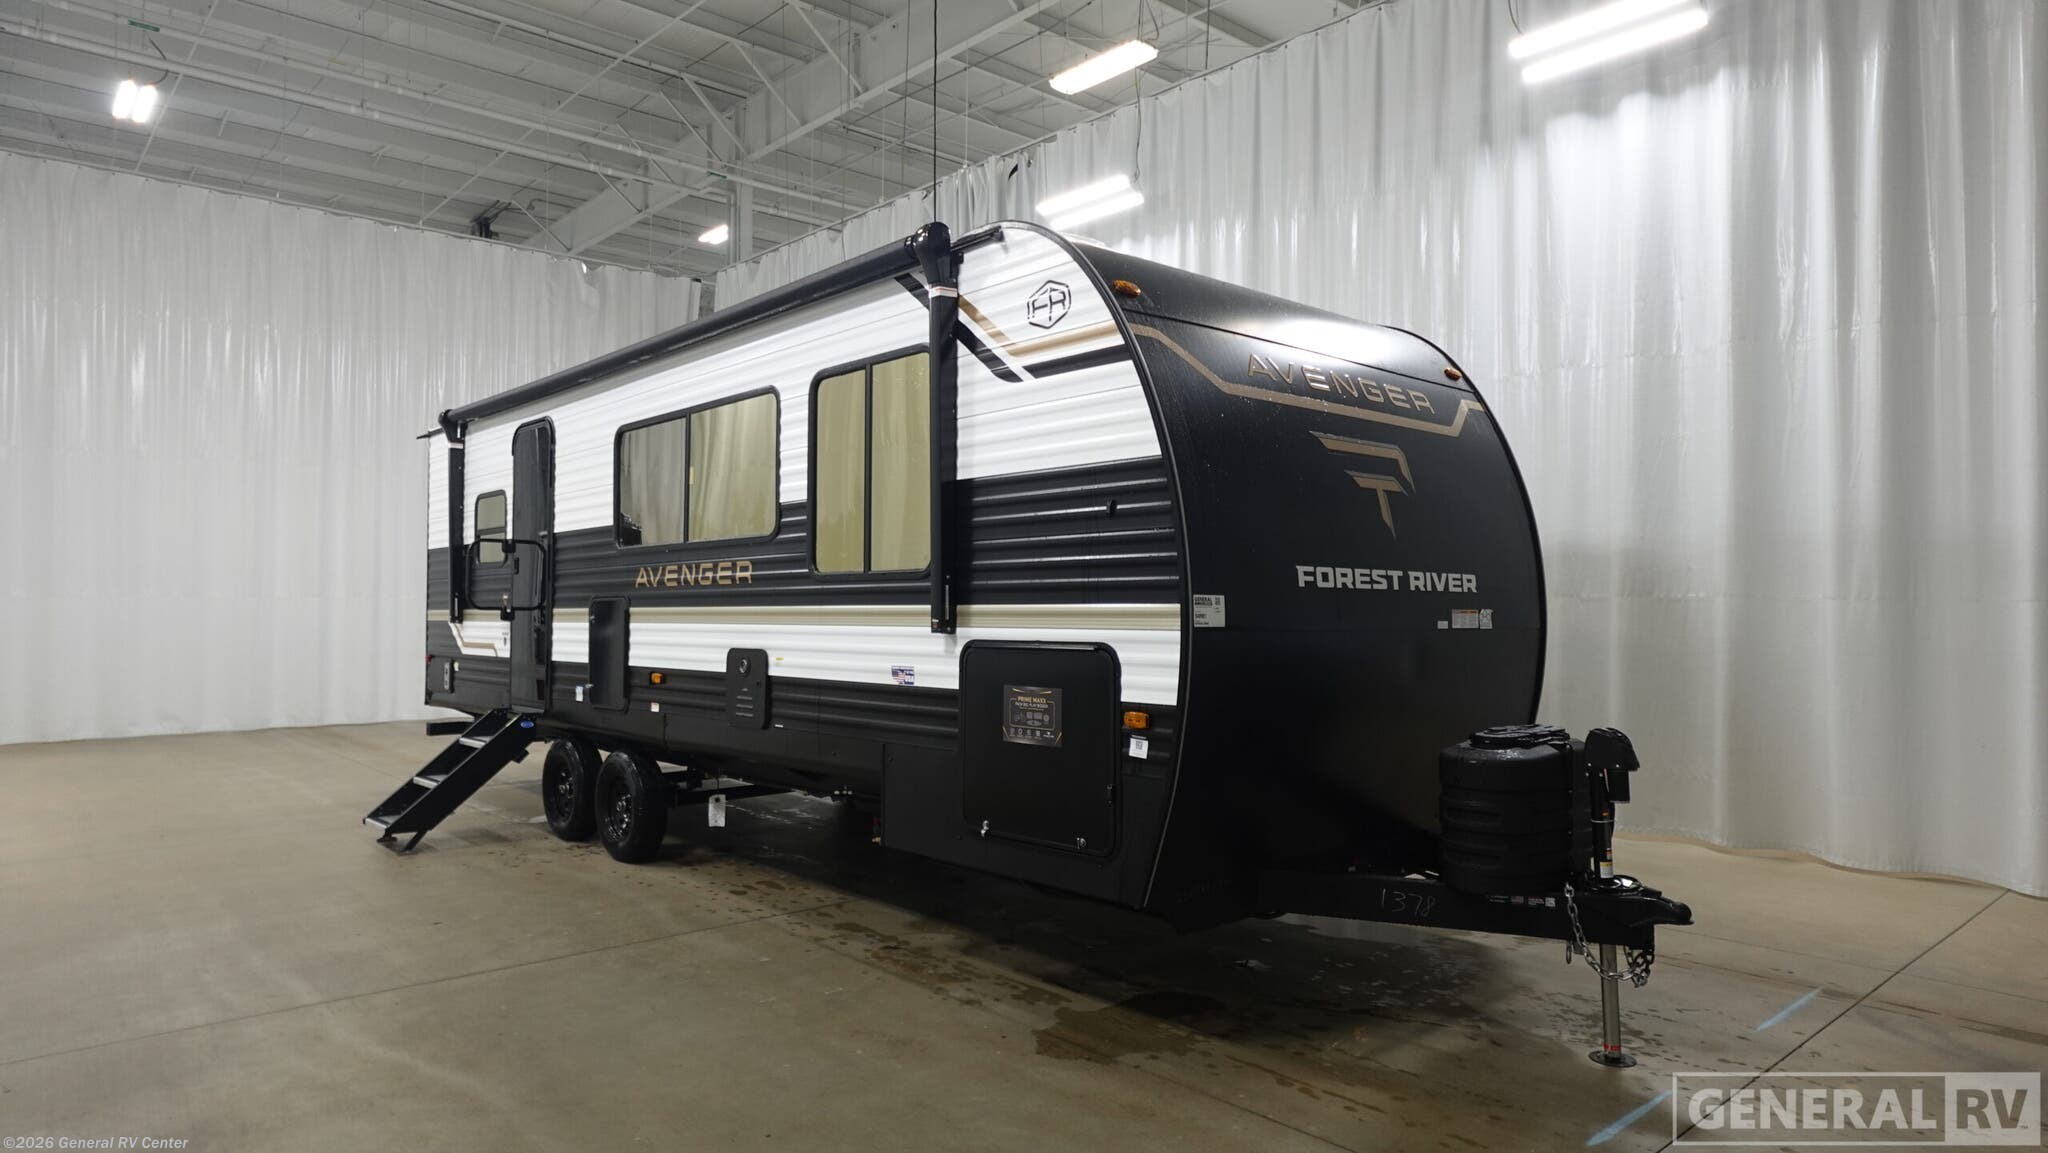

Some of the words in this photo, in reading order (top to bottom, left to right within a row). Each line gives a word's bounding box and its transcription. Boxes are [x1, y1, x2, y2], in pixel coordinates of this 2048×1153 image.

[1248, 353, 1435, 414] AVENGER
[635, 560, 753, 588] AVENGER
[1296, 565, 1403, 590] FOREST
[1408, 571, 1477, 592] RIVER
[1381, 888, 1437, 918] 1378
